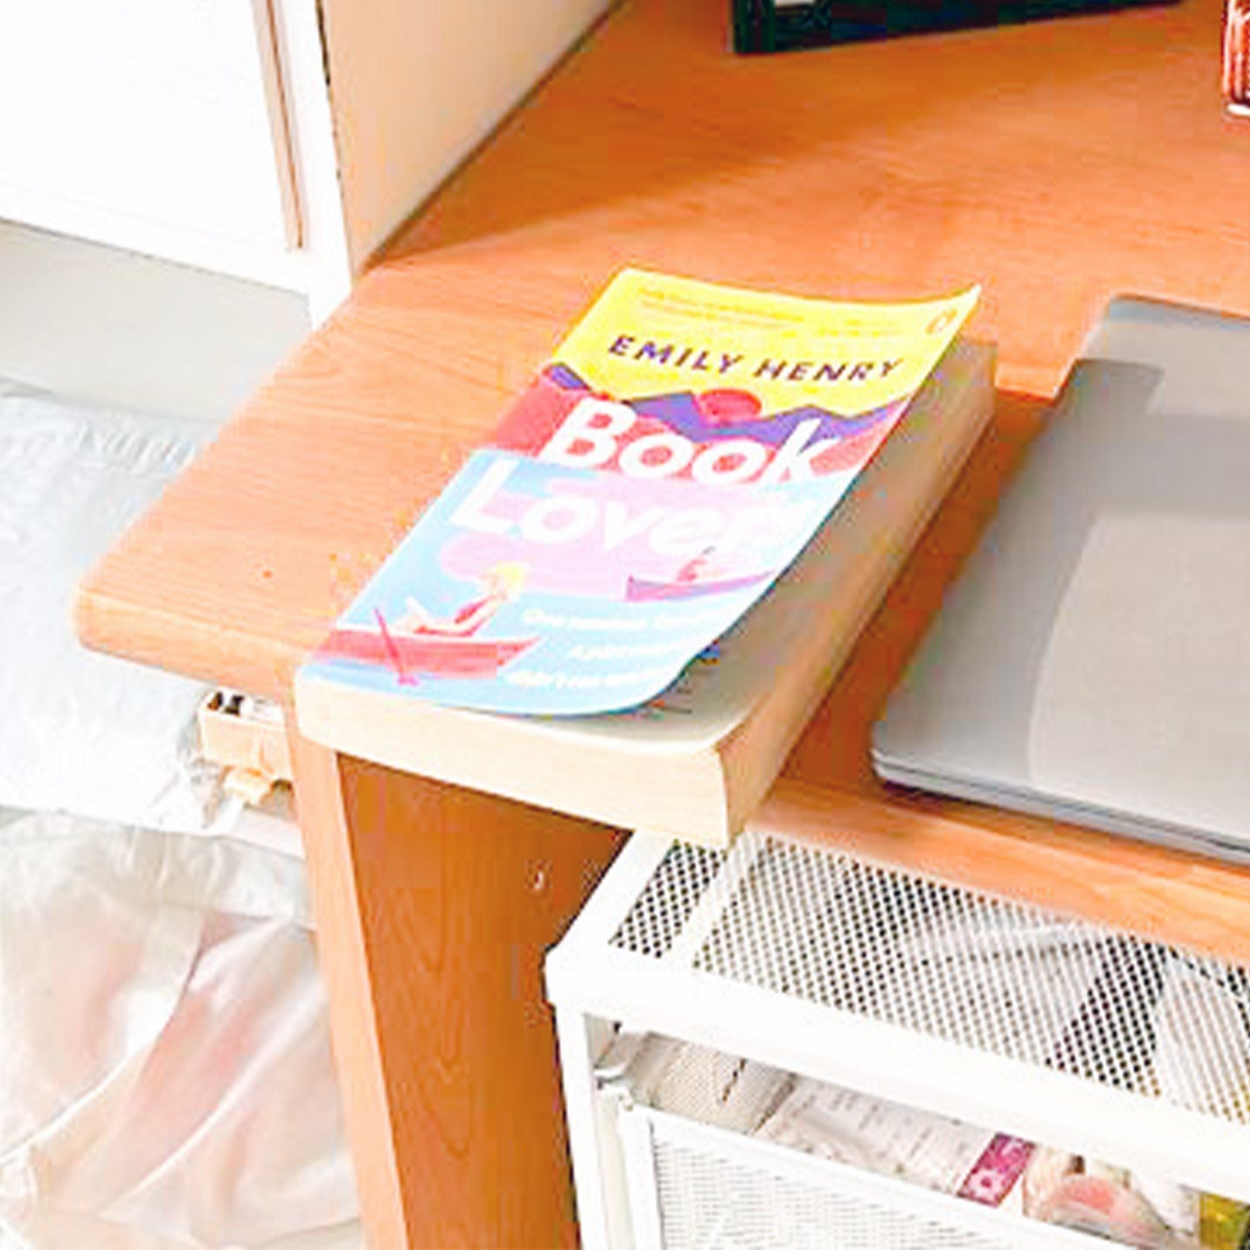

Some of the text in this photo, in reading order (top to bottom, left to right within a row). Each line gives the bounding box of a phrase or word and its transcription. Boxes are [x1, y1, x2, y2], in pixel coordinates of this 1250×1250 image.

[607, 333, 904, 382] EMILY HENRY
[538, 396, 843, 487] Book
